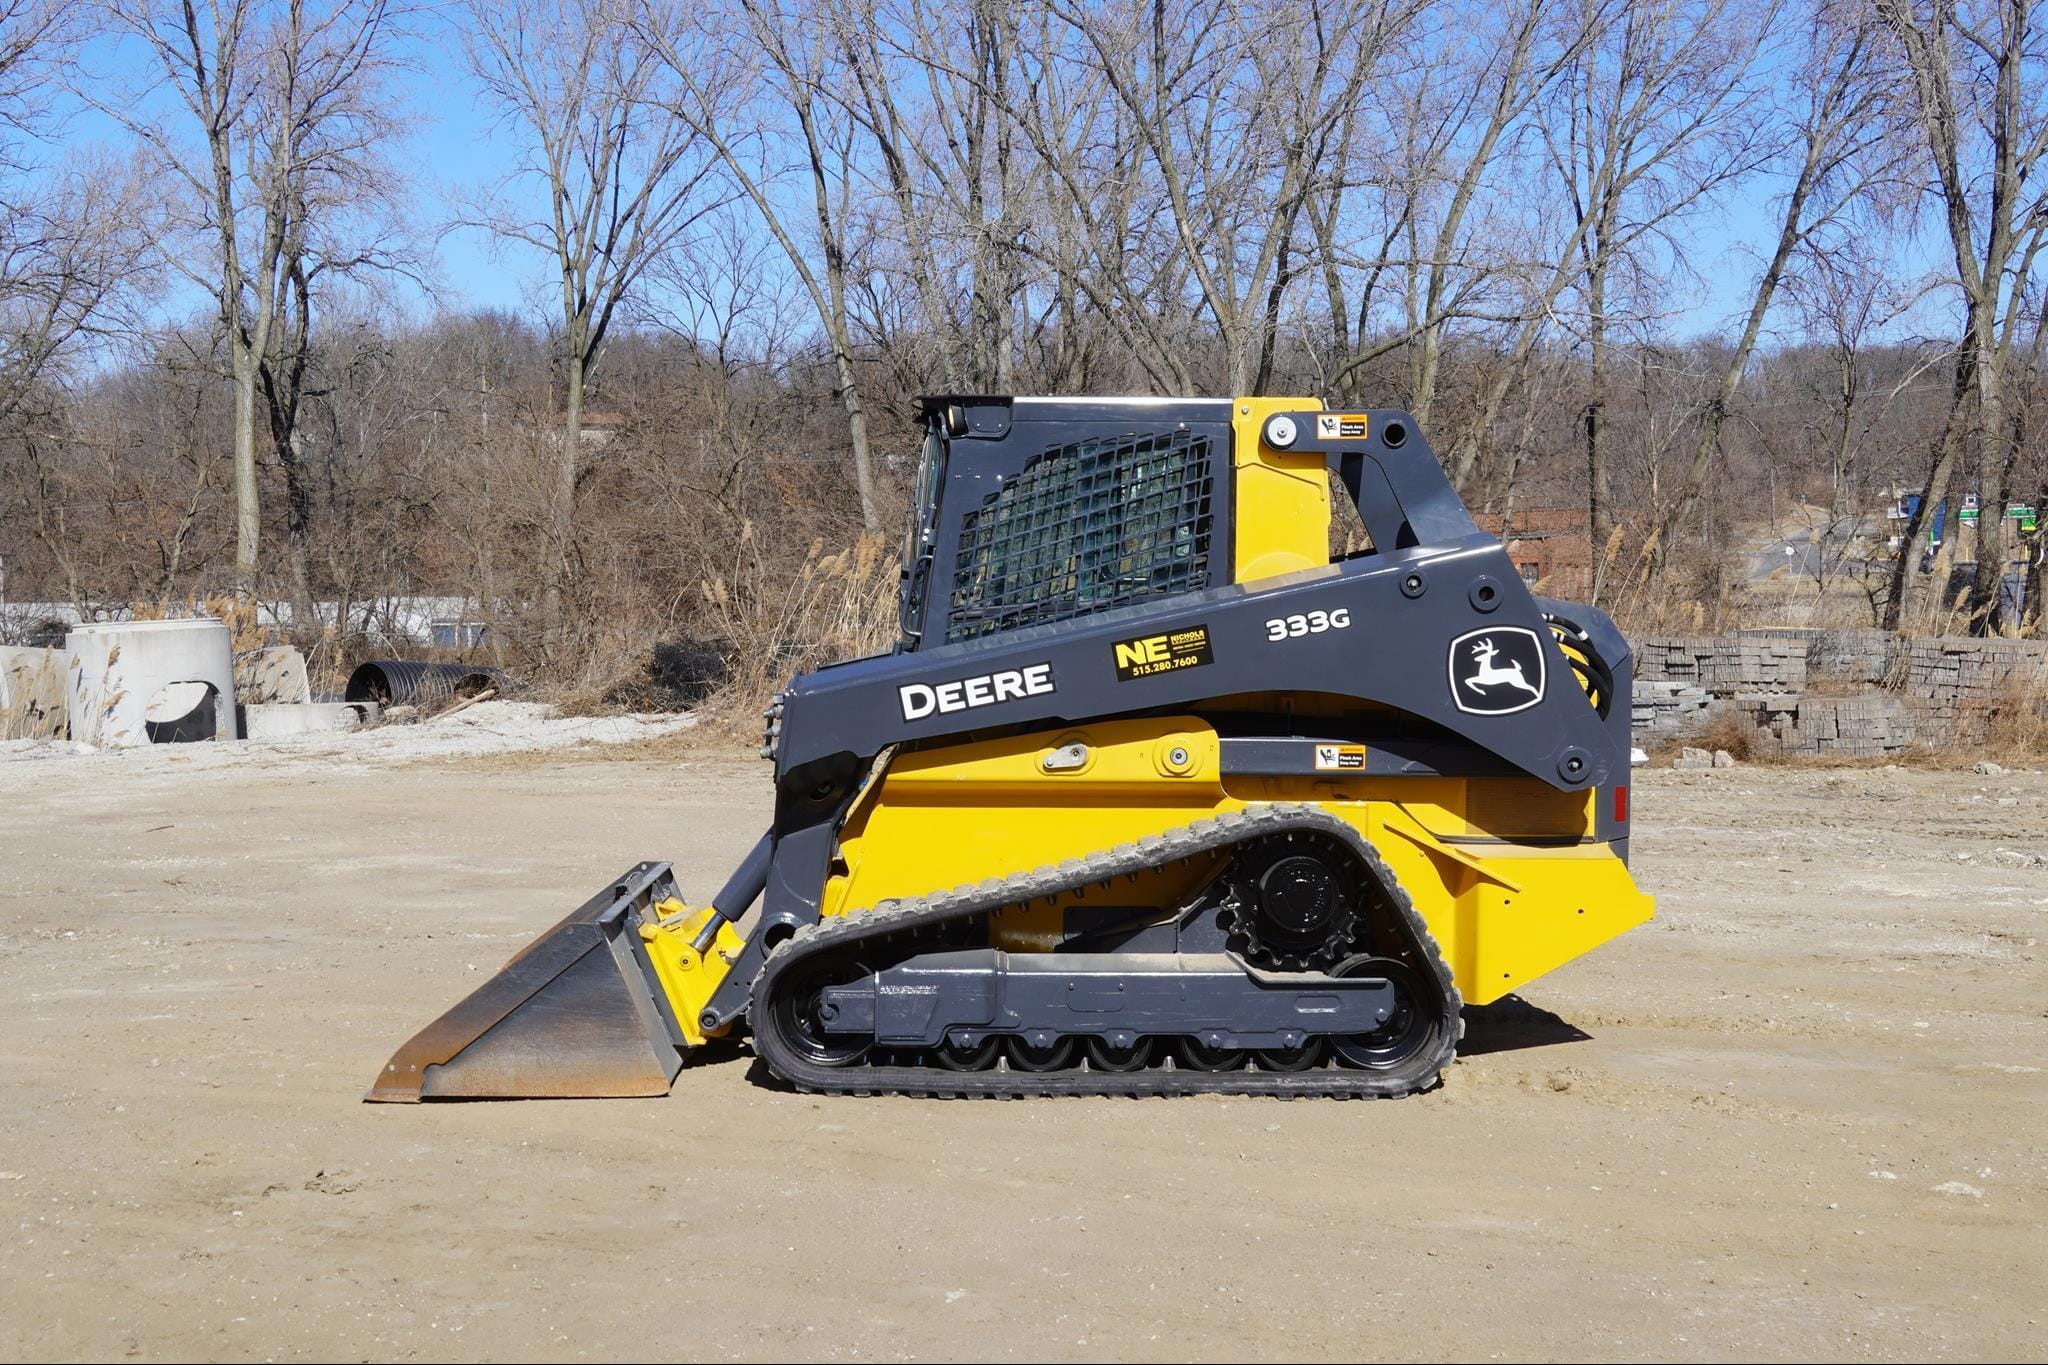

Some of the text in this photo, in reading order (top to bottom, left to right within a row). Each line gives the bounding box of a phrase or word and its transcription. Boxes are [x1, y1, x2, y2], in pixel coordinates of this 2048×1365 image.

[1170, 630, 1204, 641] NICHOLS
[1265, 608, 1351, 642] 333G
[1115, 635, 1171, 669] NE
[1133, 655, 1198, 677] 515.280.7600
[900, 663, 1054, 721] DEERE
